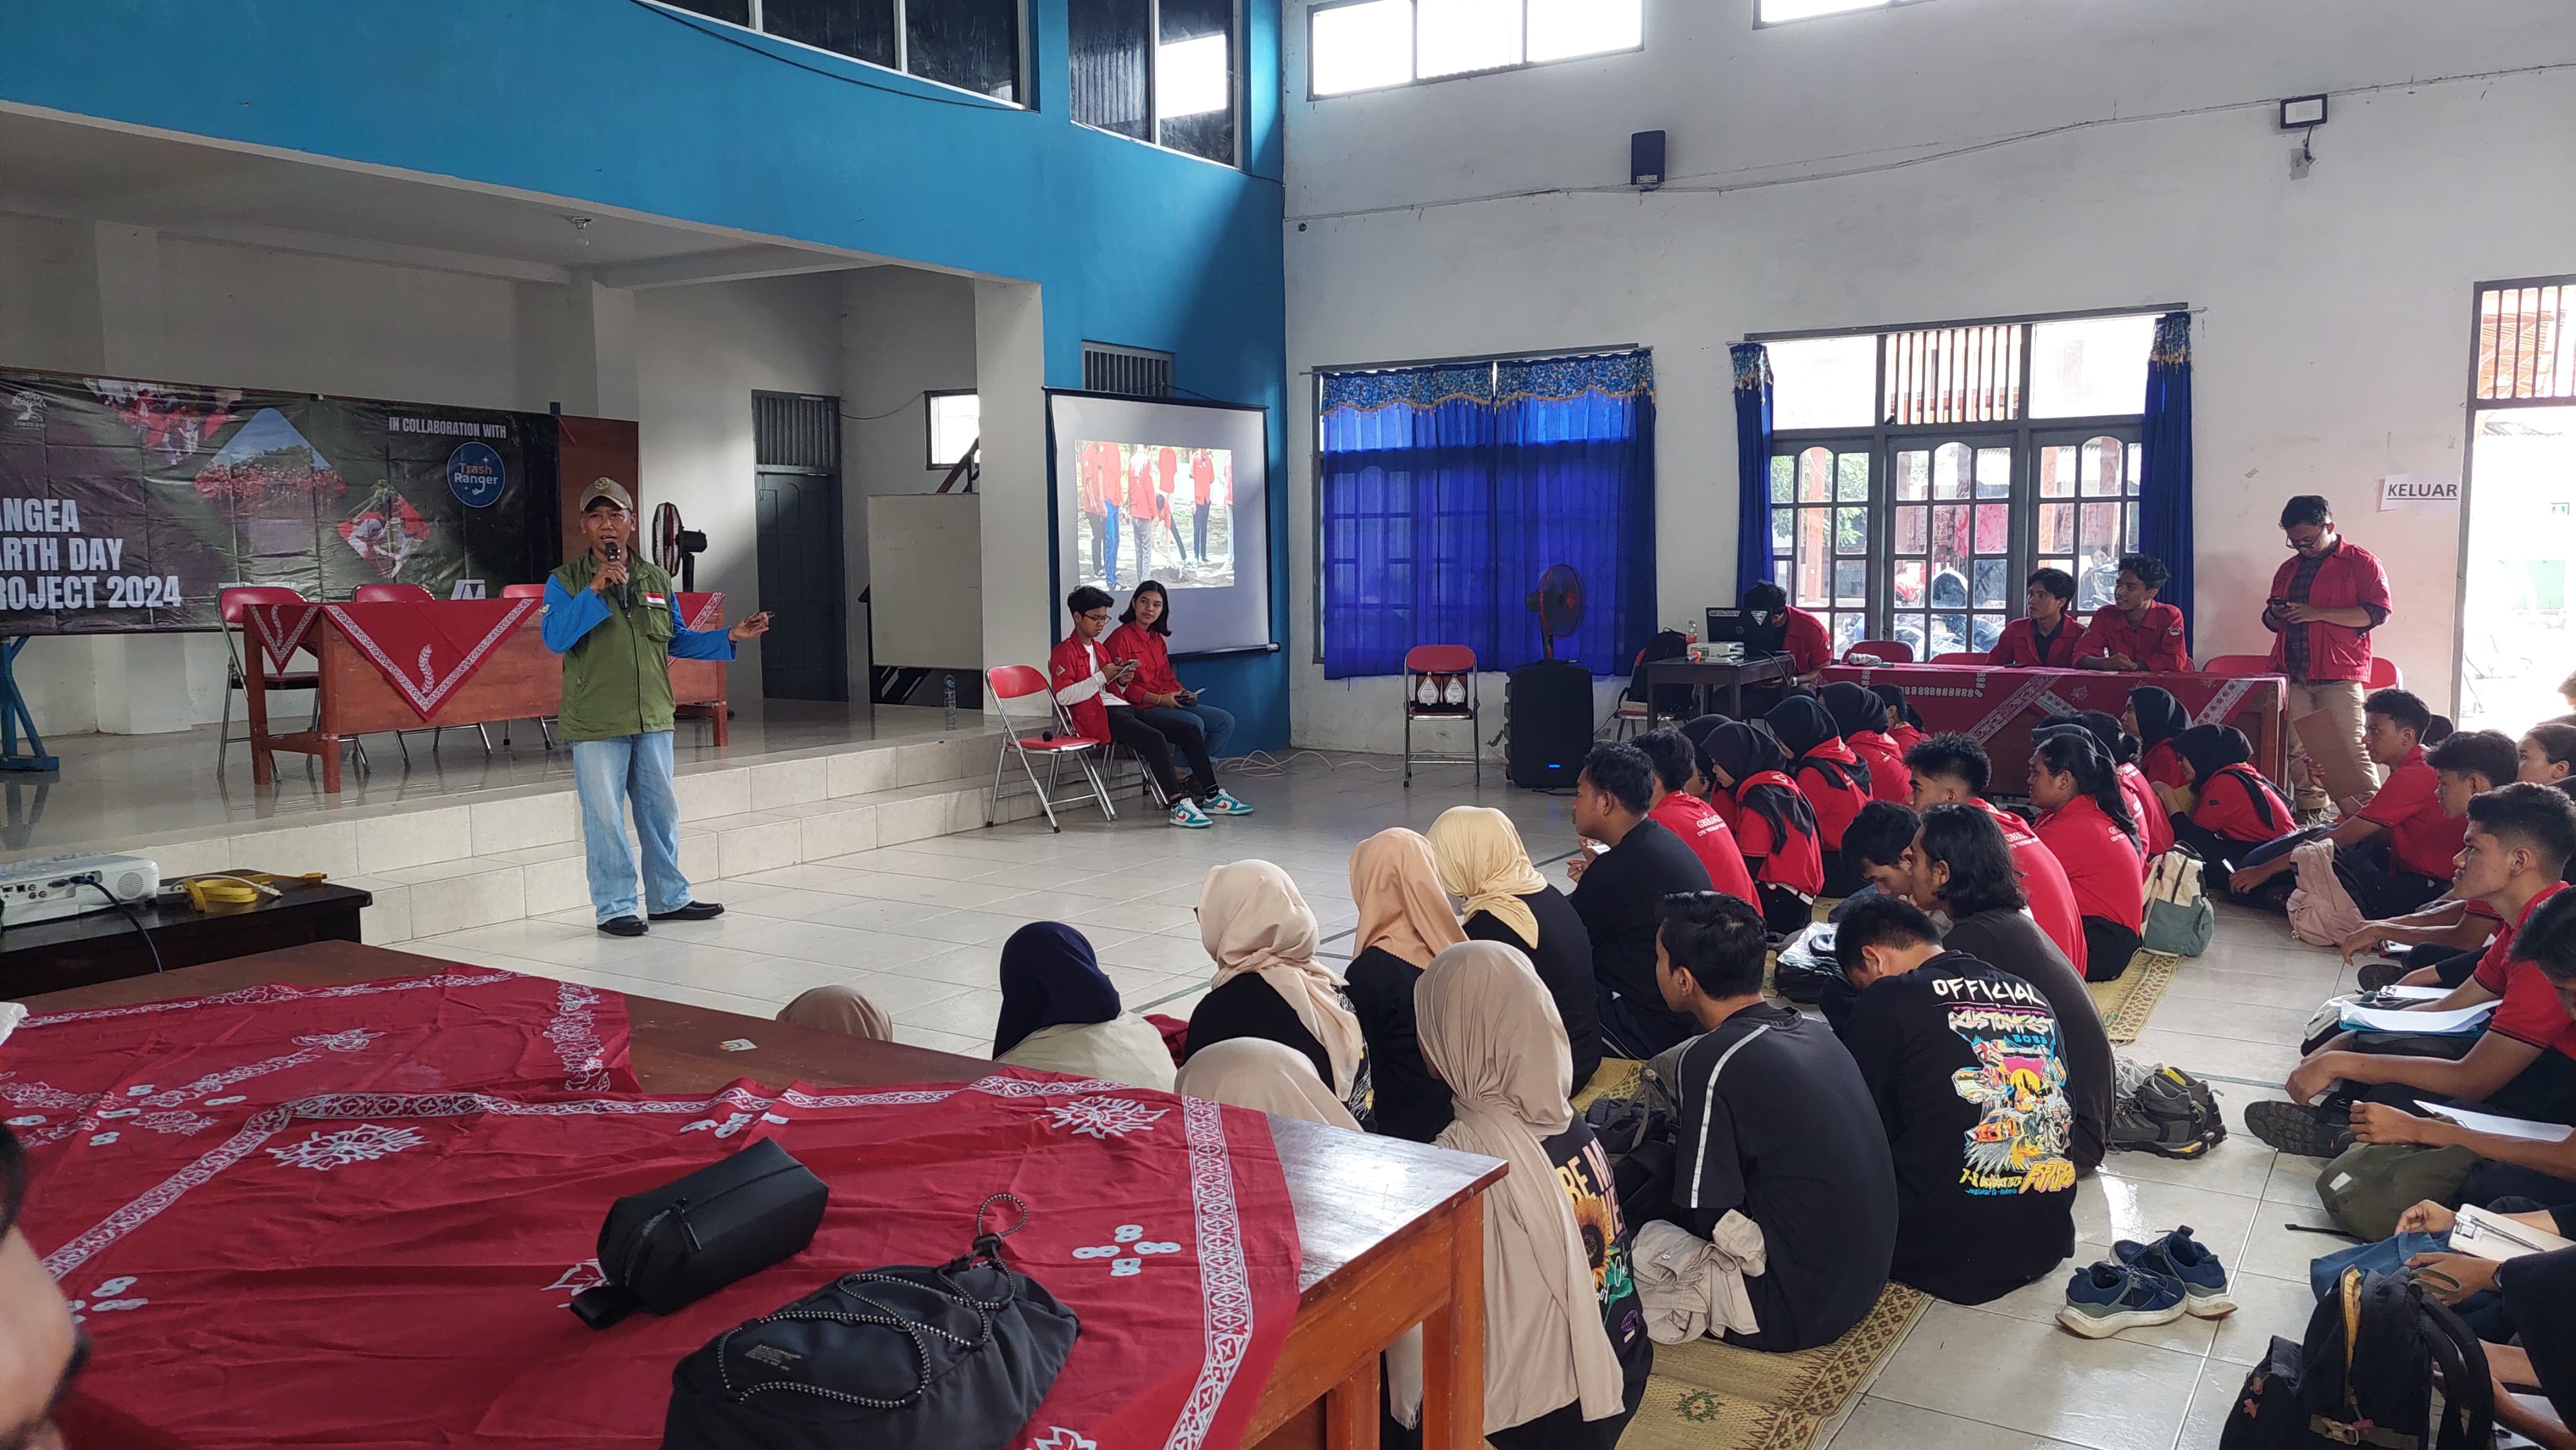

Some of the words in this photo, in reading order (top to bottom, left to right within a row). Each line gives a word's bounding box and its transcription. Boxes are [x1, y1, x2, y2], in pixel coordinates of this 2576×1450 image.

[389, 417, 399, 432] IN
[403, 418, 481, 437] COLLABORATION
[482, 423, 507, 439] WITH
[454, 472, 498, 486] Ranger
[458, 462, 492, 474] Trash
[2388, 484, 2458, 497] KELUAR
[0, 498, 80, 533] NGEA
[0, 537, 59, 571] RTH
[68, 537, 123, 571] DAY
[107, 575, 181, 609] 2024
[1931, 977, 2047, 1007] OFFICIAL
[1947, 1009, 2055, 1036] KUSTOMFEST
